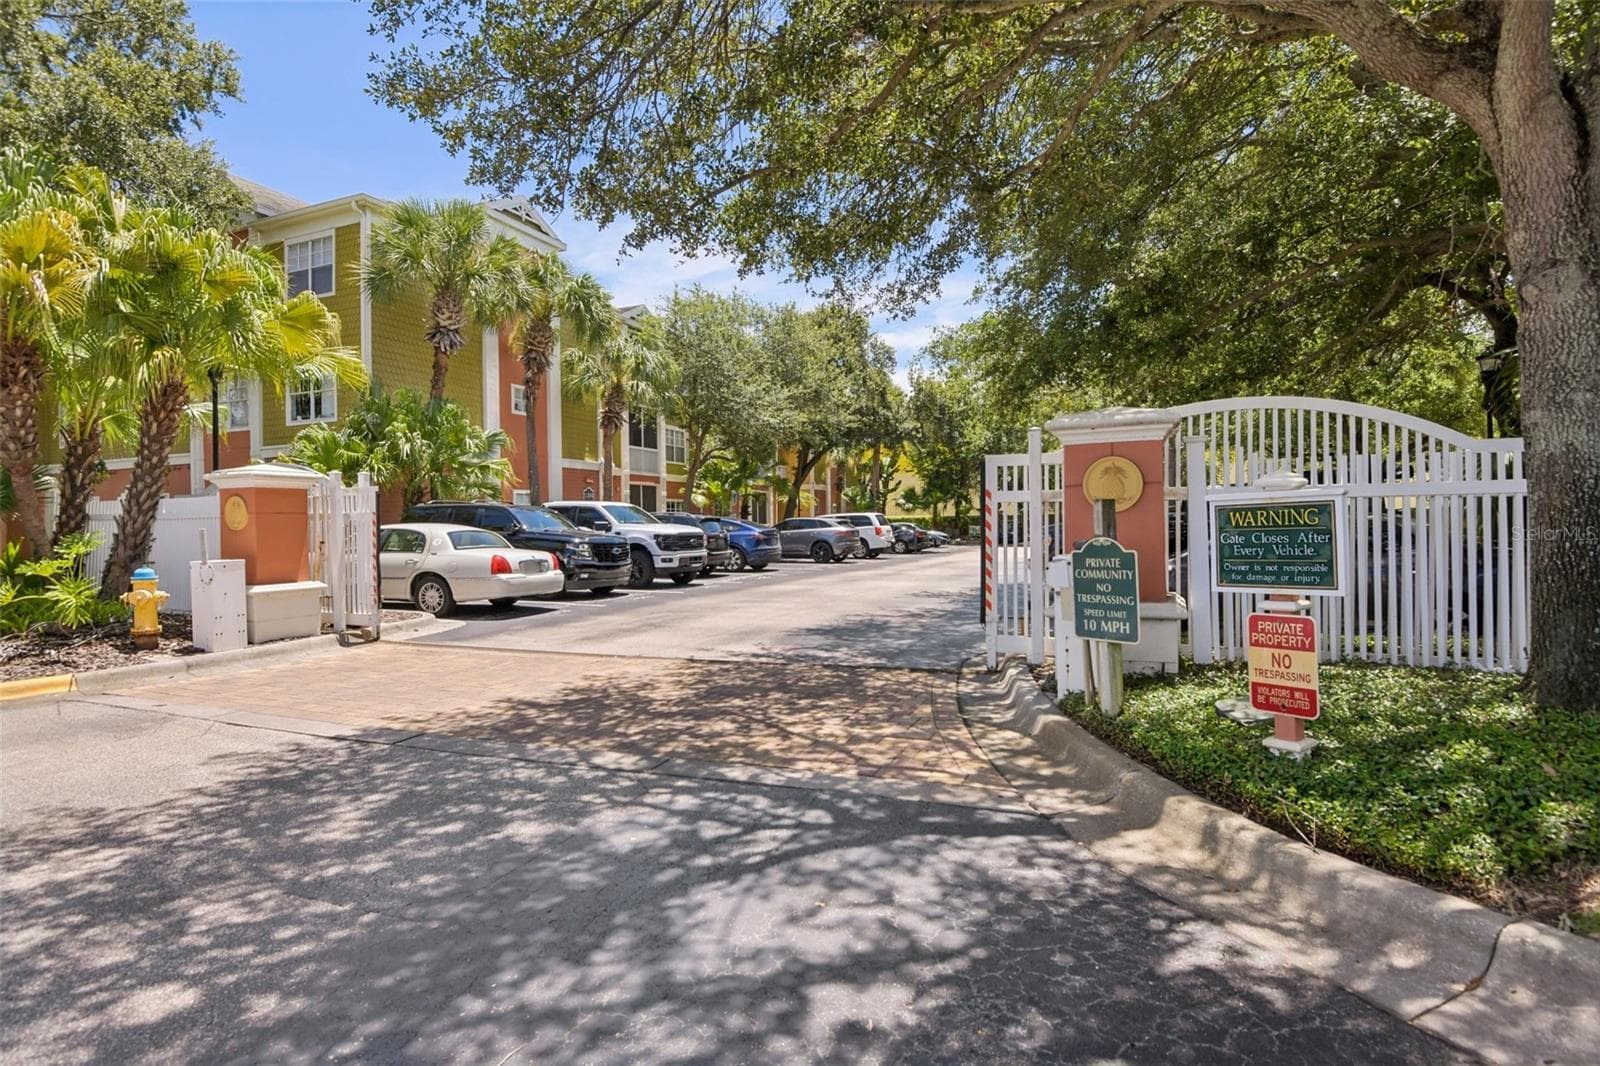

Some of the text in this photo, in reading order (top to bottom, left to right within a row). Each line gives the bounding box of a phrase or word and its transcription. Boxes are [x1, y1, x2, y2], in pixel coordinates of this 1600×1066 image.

[1230, 508, 1318, 526] WARNING
[1221, 532, 1330, 543] Gate Closes After
[1234, 545, 1317, 559] Every Vehicle.
[1086, 559, 1120, 568] PRIVATE
[1224, 563, 1249, 571] Owner
[1283, 564, 1328, 575] responsible
[1075, 569, 1133, 580] COMMUNITY
[1247, 573, 1276, 583] damage
[1096, 583, 1111, 592] NO
[1077, 594, 1134, 606] TRESPASSING
[1084, 609, 1126, 618] SPEED LIMIT
[1084, 619, 1130, 634] 10 MPH
[1258, 621, 1303, 636] PRIVATE
[1252, 633, 1311, 648] PROPERTY
[1272, 653, 1292, 669] NO
[1254, 668, 1311, 684] TRESPASSING
[1257, 686, 1309, 701] VIOLATORS WILL
[1257, 695, 1310, 709] BE PROSECUTED
